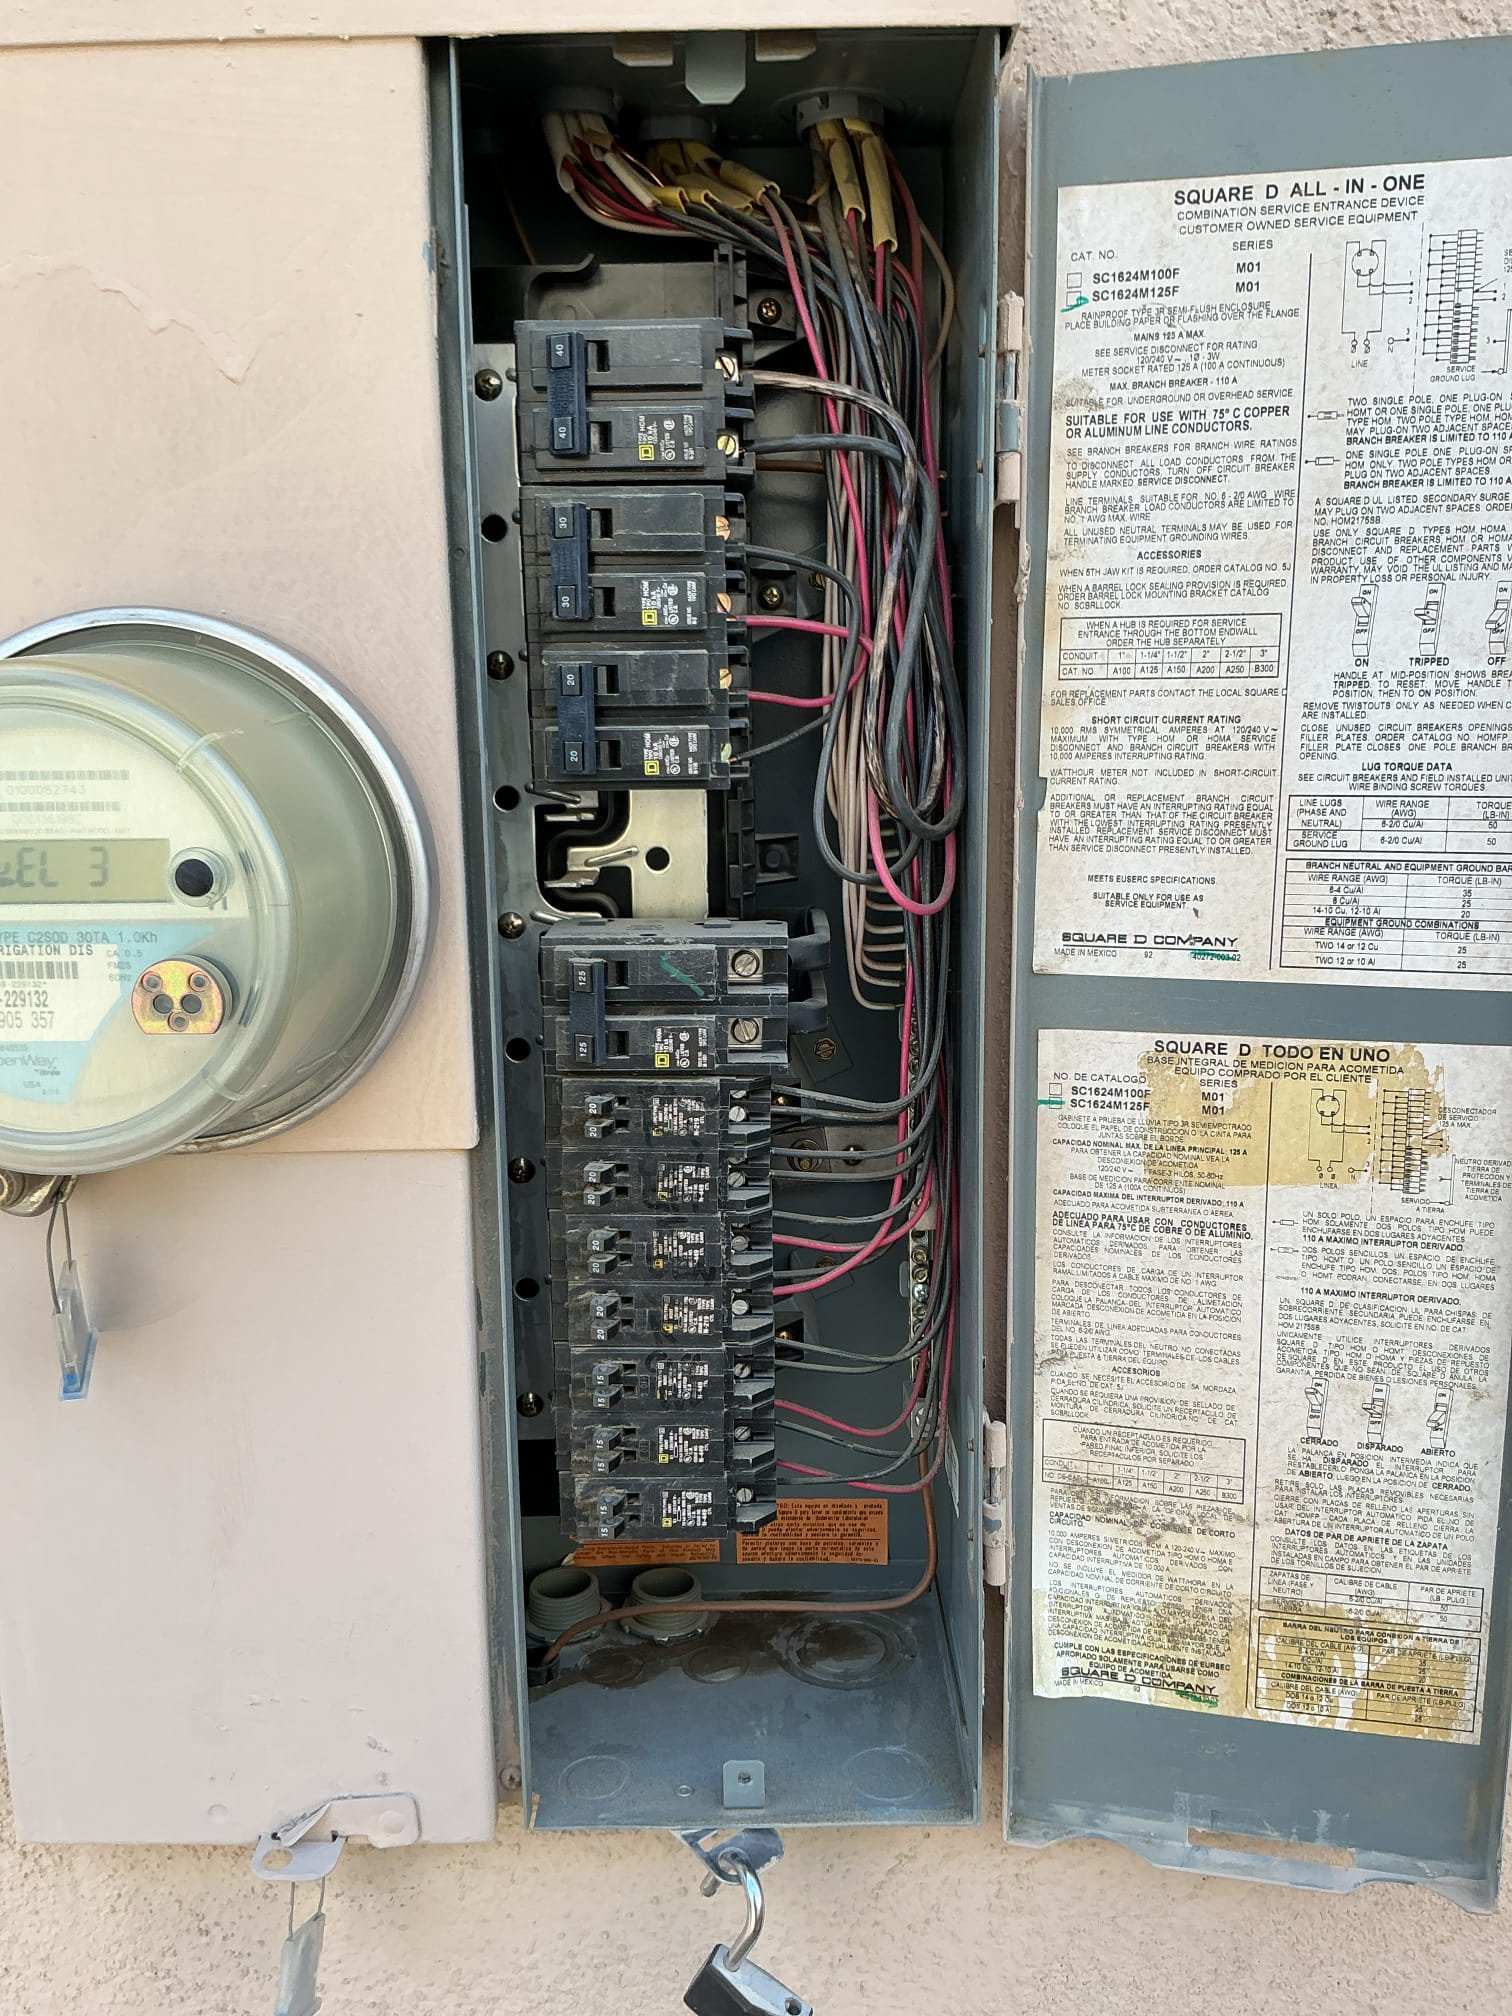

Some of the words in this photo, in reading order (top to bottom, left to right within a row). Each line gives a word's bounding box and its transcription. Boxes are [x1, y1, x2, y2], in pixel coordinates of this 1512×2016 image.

[1174, 186, 1253, 206] SQUARE
[1266, 185, 1278, 199] D
[1290, 181, 1326, 198] ALL
[1346, 178, 1364, 193] IN
[1383, 174, 1425, 192] ONE
[1178, 207, 1257, 220] COMBINATION
[1260, 204, 1310, 215] SERVICE
[1314, 199, 1377, 212] ENTRANCE
[1381, 196, 1425, 207] DEVICE
[1180, 223, 1243, 235] CUSTOMER
[1247, 219, 1291, 231] OWNED
[1294, 216, 1345, 228] SERVICE
[1349, 211, 1418, 224] EQUIPMENT
[1233, 240, 1273, 251] SERIES
[1071, 252, 1095, 262] CAT.
[1099, 250, 1117, 260] NO.
[1236, 262, 1261, 273] M01
[1093, 269, 1180, 284] SC1624M100F
[1236, 282, 1260, 293] M01
[1092, 286, 1179, 302] SC1624M125F
[556, 344, 564, 356] 40
[1110, 382, 1129, 391] MAX.
[1132, 380, 1166, 389] BRANCH
[1169, 378, 1208, 387] BREAKER
[1216, 378, 1229, 386] 110
[1231, 377, 1237, 385] A
[1066, 413, 1118, 427] SUITABLE
[1124, 412, 1145, 424] FOR
[1152, 411, 1173, 422] USE
[1179, 410, 1206, 421] WITH
[1232, 408, 1241, 418] C
[1244, 406, 1290, 418] COPPER
[558, 426, 566, 439] 40
[1066, 428, 1082, 439] OR
[1084, 423, 1142, 438] ALUMINUM
[1145, 423, 1169, 435] LINE
[1172, 420, 1252, 434] CONDUCTORS.
[560, 517, 567, 529] 30
[1137, 550, 1202, 560] ACCESSORIES
[562, 596, 569, 608] 30
[1063, 652, 1098, 661] CONDUIT
[1355, 658, 1369, 667] ON
[1409, 657, 1449, 666] TRIPPED
[1488, 657, 1506, 666] OFF
[1113, 667, 1130, 675] A100
[1140, 665, 1158, 674] A125
[1167, 665, 1185, 674] A150
[1196, 665, 1215, 674] A200
[1225, 665, 1245, 673] A250
[1255, 664, 1273, 673] B300
[567, 674, 575, 685] 20
[1092, 716, 1121, 724] SHORT
[1124, 716, 1159, 724] CIRCUIT
[1162, 716, 1206, 724] CURRENT
[1208, 716, 1241, 724] RATING
[570, 750, 578, 762] 20
[1362, 763, 1381, 771] LUG
[1385, 763, 1424, 771] TORQUE
[1427, 763, 1452, 771] DATA
[1093, 892, 1130, 900] SUITABLE
[1133, 893, 1154, 901] ONLY
[1156, 893, 1173, 901] FOR
[1193, 894, 1204, 902] AS
[1141, 901, 1188, 909] EQUIPMENT.
[1325, 918, 1373, 927] EQUIPMENT
[1376, 920, 1412, 928] GROUND
[1415, 921, 1479, 930] COMBINATIONS
[1062, 932, 1127, 943] SQUARE
[1134, 935, 1147, 944] D
[1154, 936, 1238, 946] COMPANY
[70, 945, 93, 956] DIS
[1054, 948, 1075, 956] MADE
[1087, 949, 1117, 957] MEXICO
[31, 1011, 54, 1029] 357
[579, 1042, 587, 1056] 125
[1154, 1040, 1228, 1056] SQUARE
[1239, 1043, 1251, 1055] D
[1263, 1045, 1313, 1059] TODO
[1320, 1047, 1343, 1060] EN
[1351, 1049, 1390, 1062] UNO
[1147, 1056, 1174, 1065] BASE
[1176, 1057, 1229, 1068] INTEGRAL
[1233, 1059, 1247, 1068] DE
[1250, 1060, 1304, 1071] MEDICION
[1307, 1063, 1335, 1072] PARA
[1339, 1064, 1404, 1074] ACOMETIDA
[1054, 1072, 1071, 1080] NO.
[1074, 1073, 1088, 1081] DE
[1091, 1074, 1146, 1084] CATALOGO
[1175, 1066, 1215, 1076] EQUIPO
[1218, 1068, 1281, 1080] COMPRADO
[1284, 1072, 1306, 1081] POR
[1310, 1073, 1322, 1081] EL
[1326, 1074, 1372, 1083] CLIENTE
[1199, 1079, 1238, 1088] SERIES
[1071, 1086, 1151, 1098] SC1624M100F
[1202, 1092, 1225, 1101] M01
[588, 1103, 597, 1114] 20
[1070, 1099, 1150, 1111] SC1624M125F
[1202, 1106, 1225, 1115] M01
[590, 1127, 597, 1136] 20
[589, 1172, 596, 1182] 20
[588, 1194, 596, 1204] 20
[593, 1240, 600, 1251] 20
[593, 1263, 600, 1273] 20
[596, 1307, 604, 1317] 20
[597, 1329, 605, 1340] 20
[597, 1375, 605, 1385] 15
[598, 1398, 605, 1407] 15
[596, 1440, 603, 1448] 15
[1300, 1437, 1338, 1447] CERRADO
[1357, 1442, 1403, 1452] DISPARADO
[1421, 1448, 1455, 1457] ABIERTO
[598, 1463, 605, 1472] 15
[600, 1505, 607, 1514] 15
[601, 1528, 608, 1536] 15
[1061, 1667, 1118, 1679] SQUARE
[1142, 1678, 1218, 1693] COMPANY
